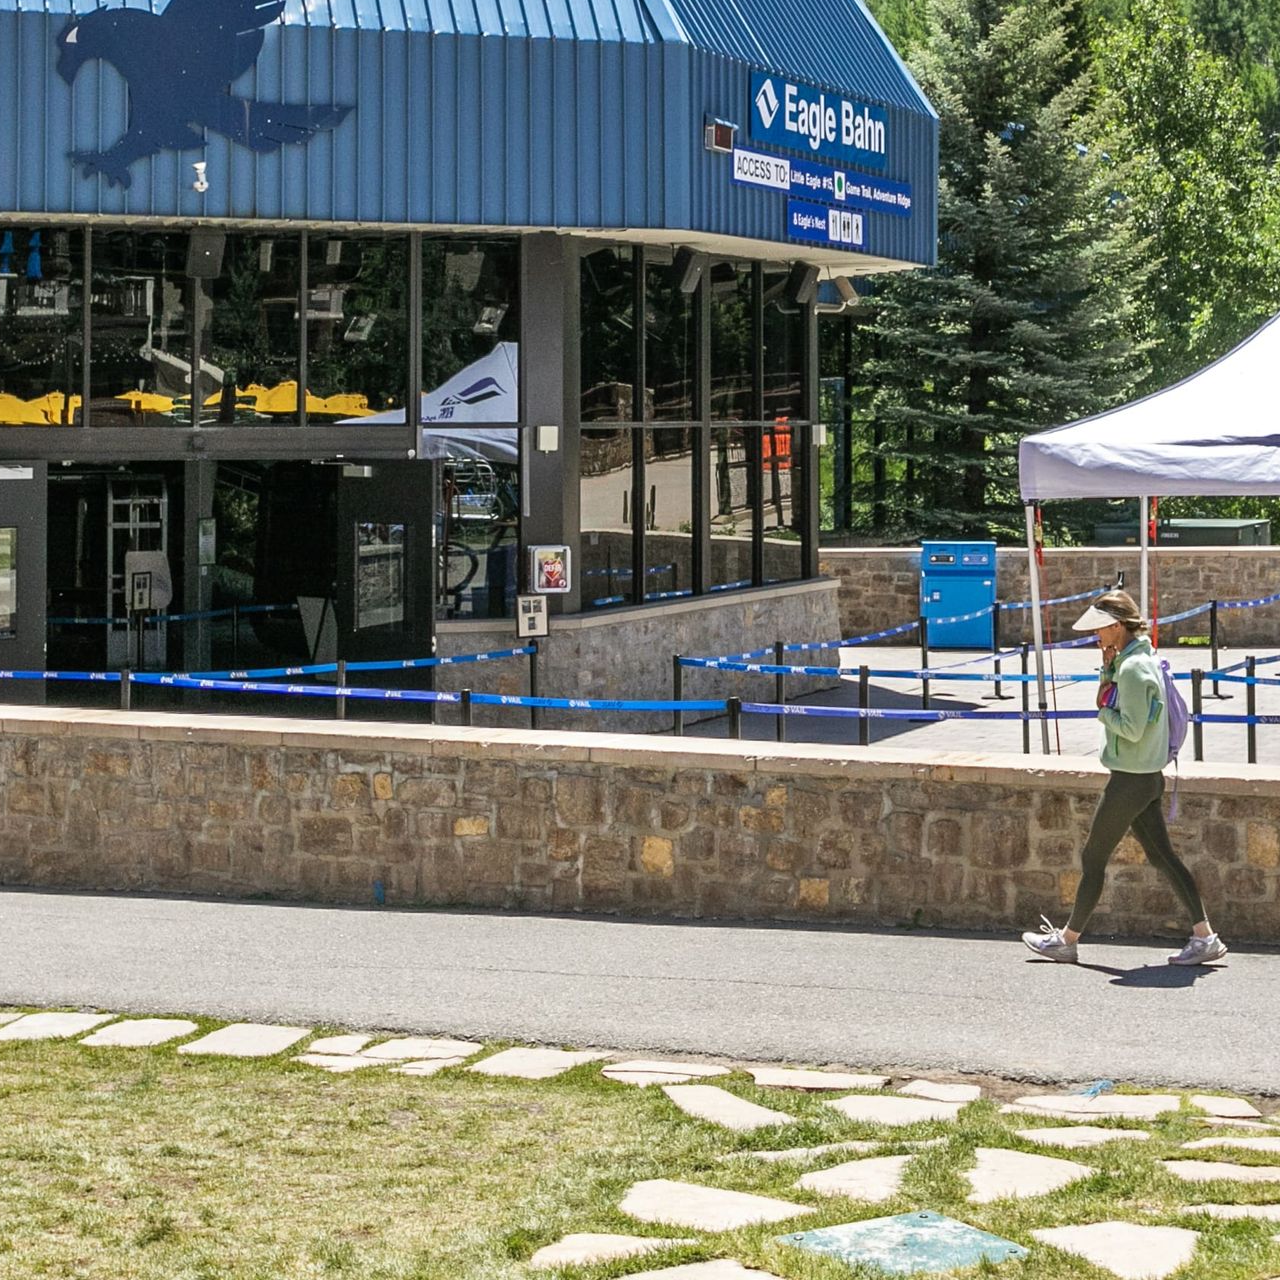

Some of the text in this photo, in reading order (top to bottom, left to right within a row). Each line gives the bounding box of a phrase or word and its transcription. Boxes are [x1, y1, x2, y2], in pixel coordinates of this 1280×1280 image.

[784, 83, 885, 154] Eagle Bahn
[737, 157, 771, 180] ACCESS
[775, 163, 788, 183] TO:
[791, 169, 804, 184] Little
[806, 173, 821, 190] Eagle
[822, 176, 834, 192] #15,
[846, 182, 860, 196] Game
[873, 185, 896, 204] Adventure
[898, 193, 911, 209] Ridge
[798, 213, 814, 231] Eagle's
[814, 217, 826, 230] Nest
[508, 696, 523, 704] VAIL
[576, 700, 592, 708] VAIL
[790, 706, 807, 714] VAIL
[867, 709, 885, 717] VAIL
[946, 711, 964, 719] VAIL
[1027, 711, 1045, 719] VAIL
